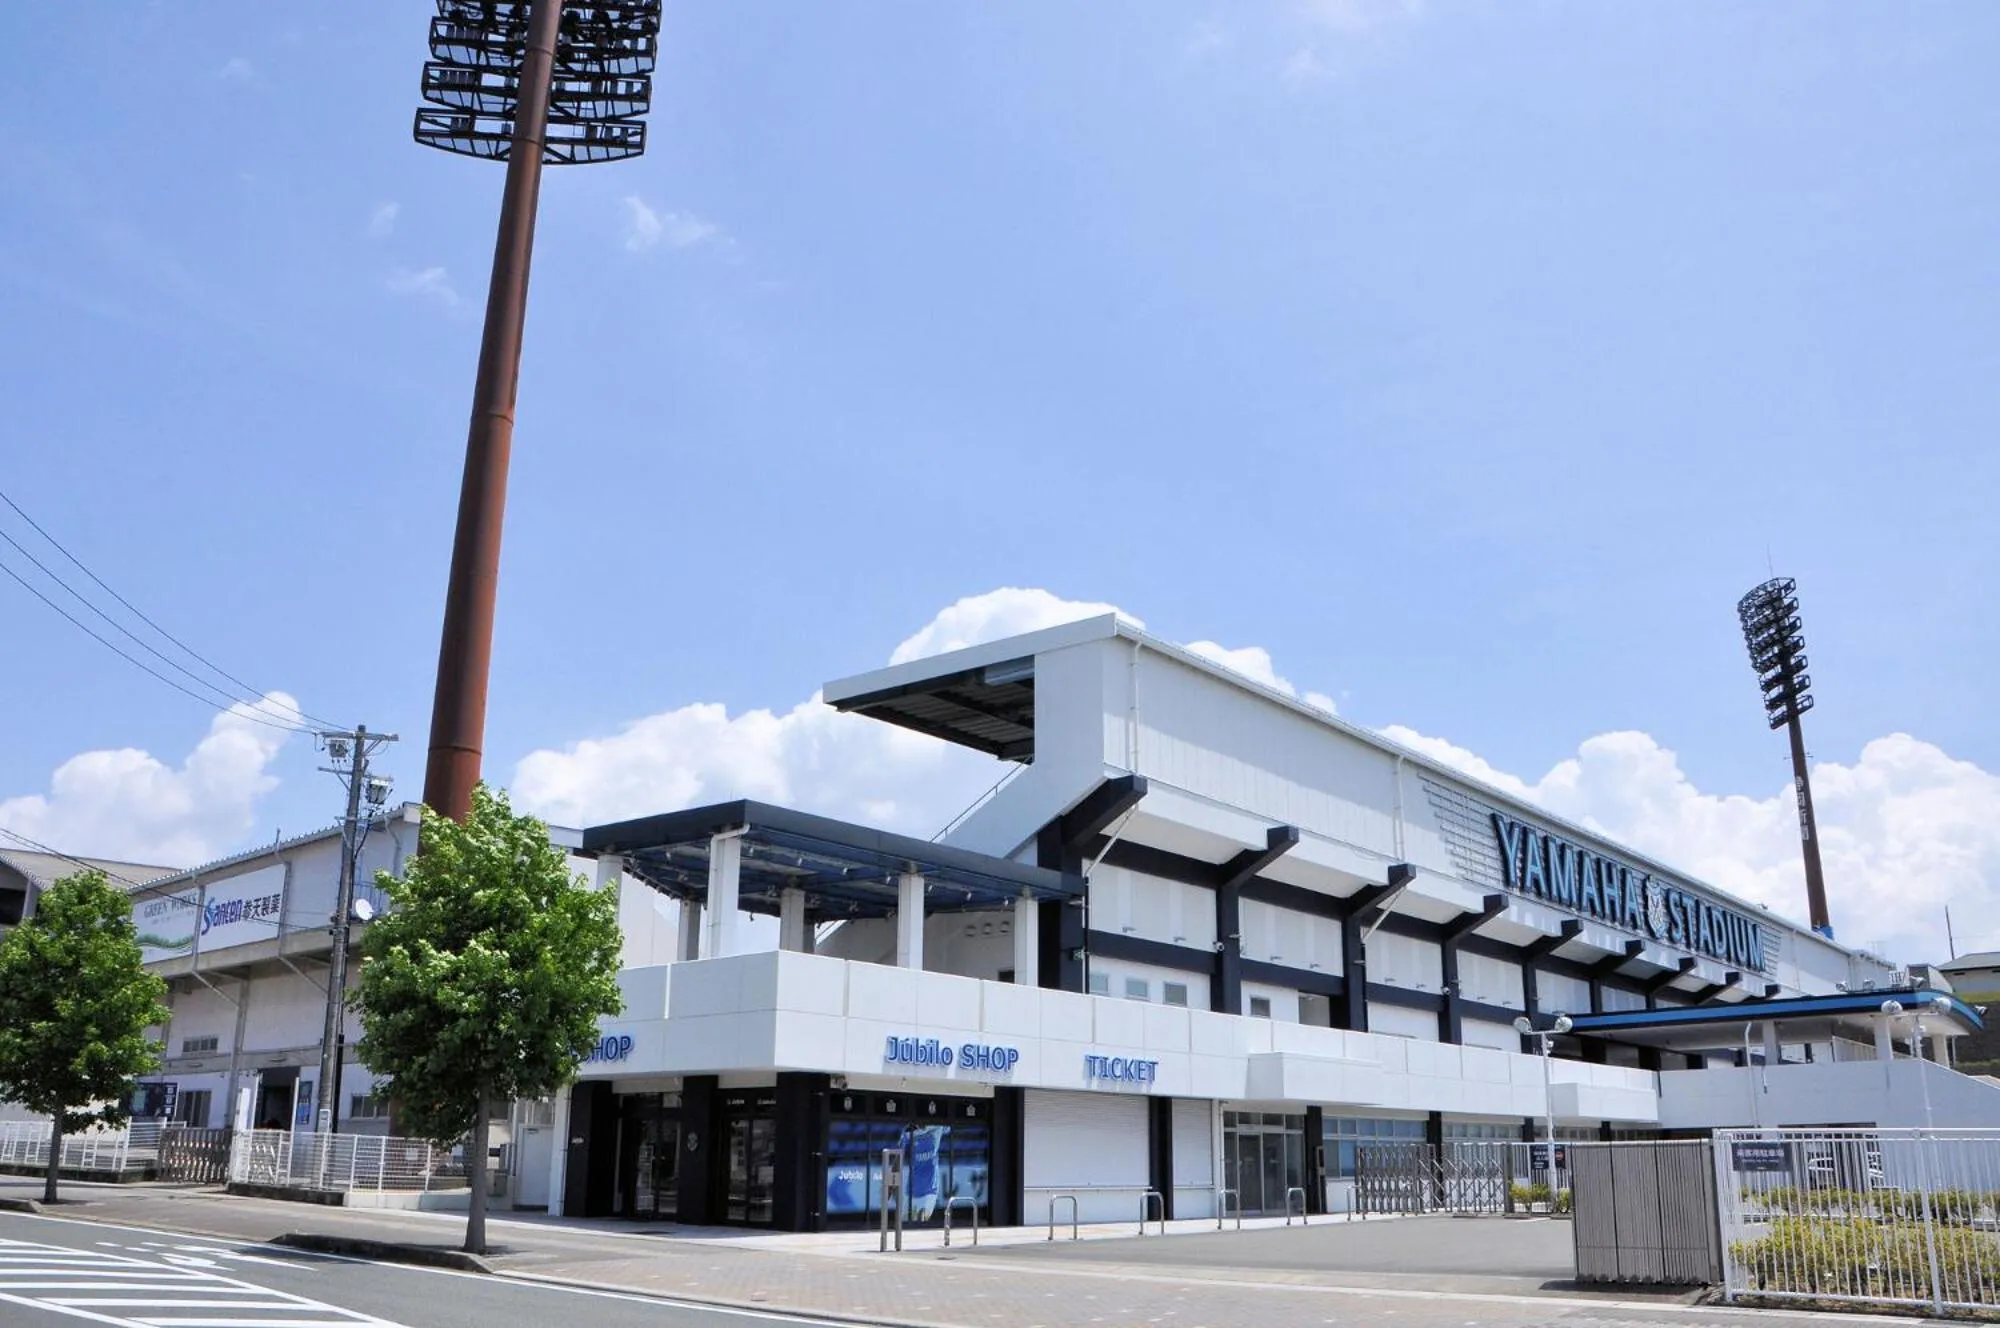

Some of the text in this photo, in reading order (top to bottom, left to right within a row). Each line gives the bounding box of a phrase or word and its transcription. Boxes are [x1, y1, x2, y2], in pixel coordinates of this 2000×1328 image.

[1492, 813, 1767, 972] YAMAHA STADIUM
[886, 1035, 1020, 1071] Júbilo SHOP
[1085, 1055, 1159, 1082] TICKET
